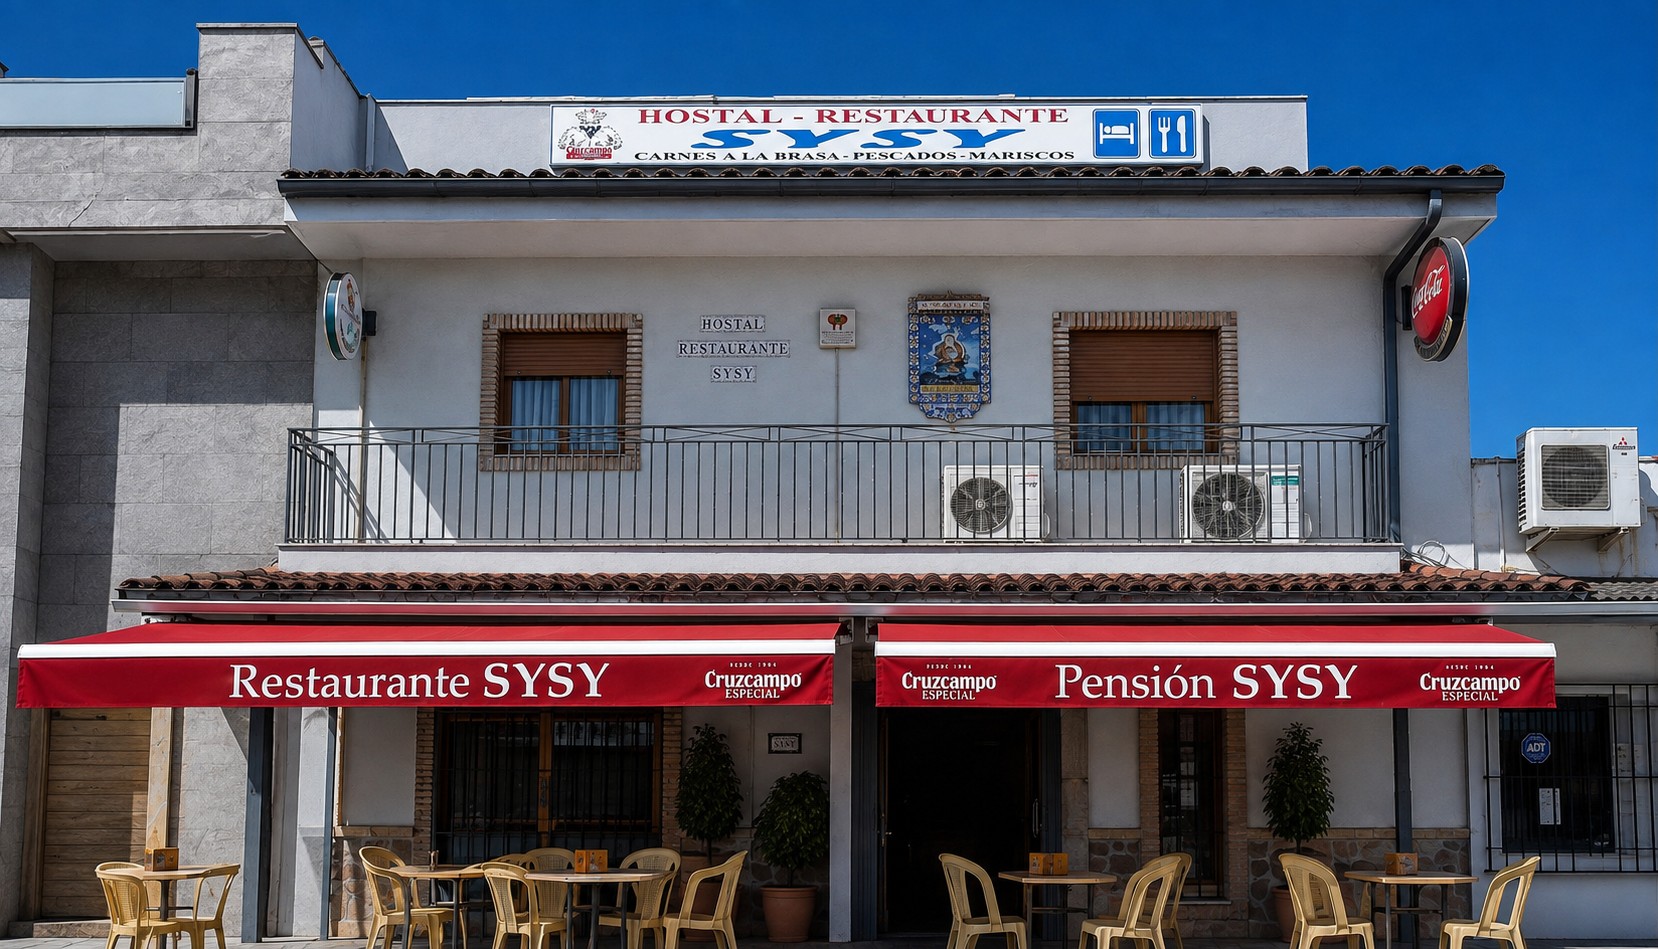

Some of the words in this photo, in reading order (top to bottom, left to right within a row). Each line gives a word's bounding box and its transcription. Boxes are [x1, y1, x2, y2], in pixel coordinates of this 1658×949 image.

[638, 109, 783, 124] HOSTAL
[815, 108, 1069, 124] RESTAURANTE
[690, 128, 1026, 149] SYSY
[634, 152, 717, 161] CARNES
[723, 152, 736, 161] A
[742, 152, 769, 161] LA
[853, 151, 957, 160] PESCADOS
[969, 151, 1075, 160] MARISCOS
[702, 319, 764, 330] HOSTAL
[679, 343, 789, 355] RESTAURANTE
[713, 367, 753, 379] SYSY
[229, 664, 470, 698] Restaurante
[483, 662, 610, 698] SYSY
[704, 669, 802, 691] Cruzcampo
[901, 671, 997, 693] Cruzcampo
[1055, 664, 1217, 699] Pensión
[1232, 663, 1358, 699] SYSY
[1419, 672, 1521, 694] Cruzcampo
[725, 688, 780, 699] ESPECIAL
[922, 690, 976, 700] ESPECIAL
[1442, 691, 1498, 701] ESPECIAL
[1526, 742, 1546, 753] ADT
